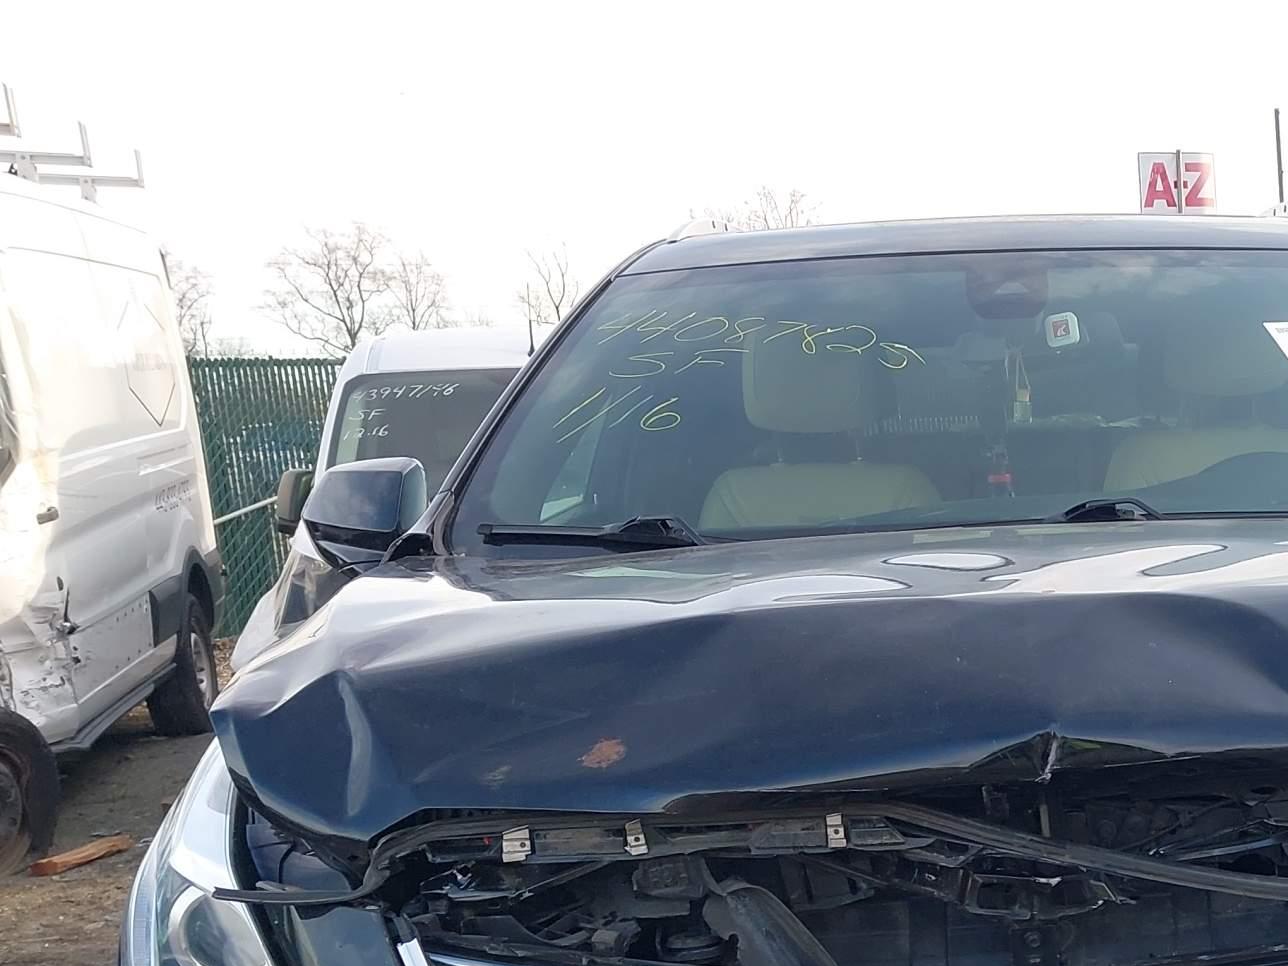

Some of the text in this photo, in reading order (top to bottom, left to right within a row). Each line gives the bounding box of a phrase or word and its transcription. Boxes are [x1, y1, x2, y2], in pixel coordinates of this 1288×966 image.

[1144, 162, 1213, 208] A-Z
[597, 310, 927, 369] 44087825
[552, 385, 682, 443] 1/16
